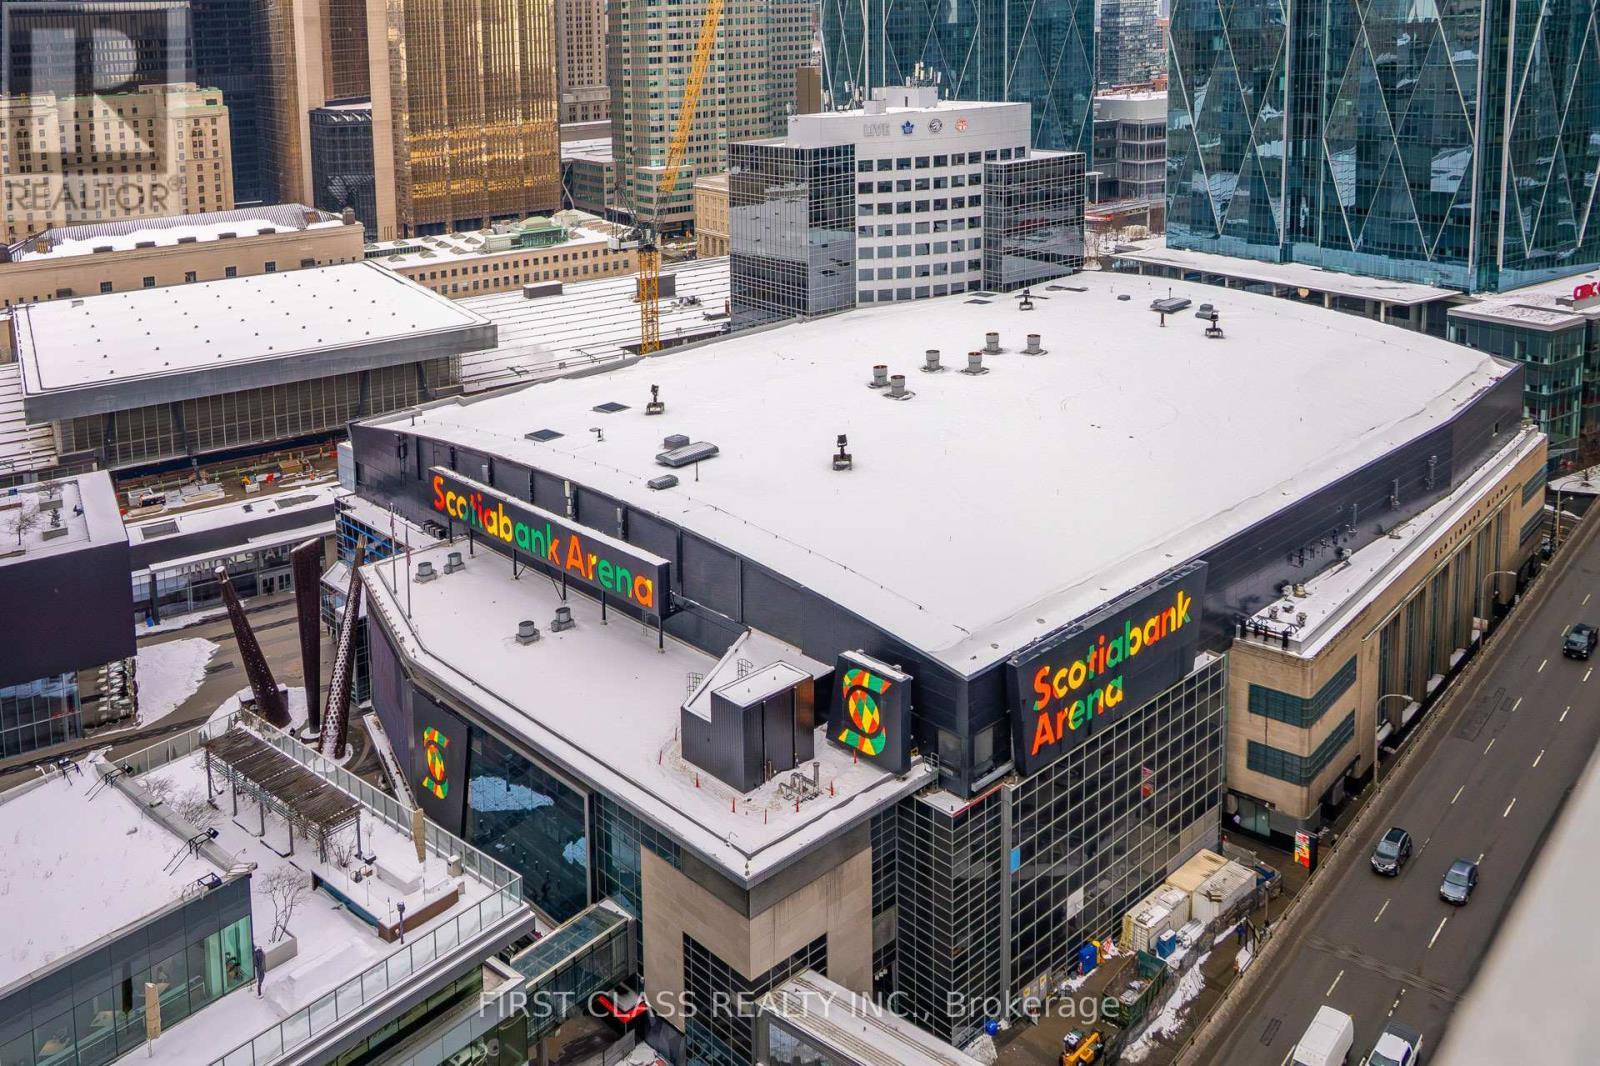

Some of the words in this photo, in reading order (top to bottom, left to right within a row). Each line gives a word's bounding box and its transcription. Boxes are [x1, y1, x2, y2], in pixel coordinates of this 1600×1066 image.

[432, 475, 561, 566] Scotiabank
[565, 535, 653, 608] Arena
[1033, 591, 1192, 711] Scotiabank
[1031, 675, 1124, 757] Arena
